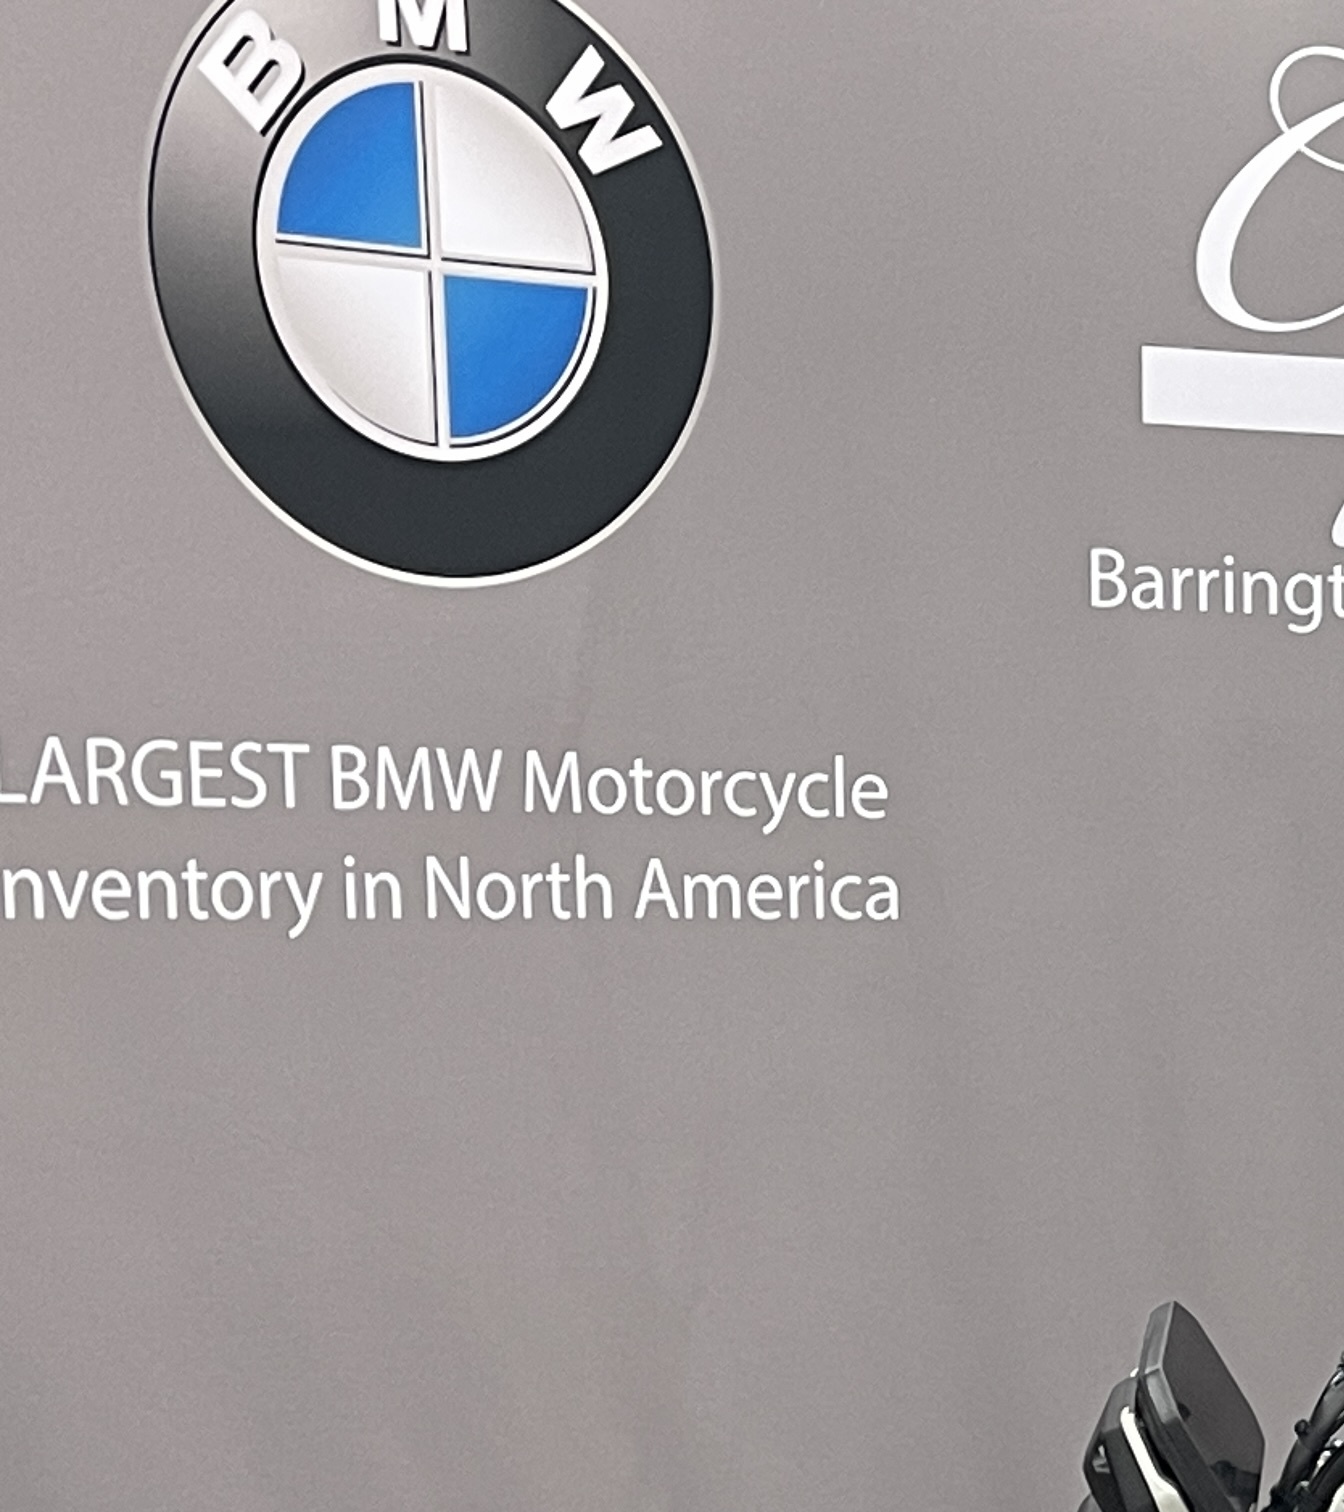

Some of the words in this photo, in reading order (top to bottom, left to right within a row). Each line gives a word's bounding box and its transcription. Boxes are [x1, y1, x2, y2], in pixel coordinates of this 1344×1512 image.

[331, 744, 503, 812] BMW
[524, 749, 889, 835] Motorcycle
[2, 857, 323, 940] nventory
[344, 854, 402, 919] in
[425, 854, 613, 920] North
[634, 857, 900, 921] America
